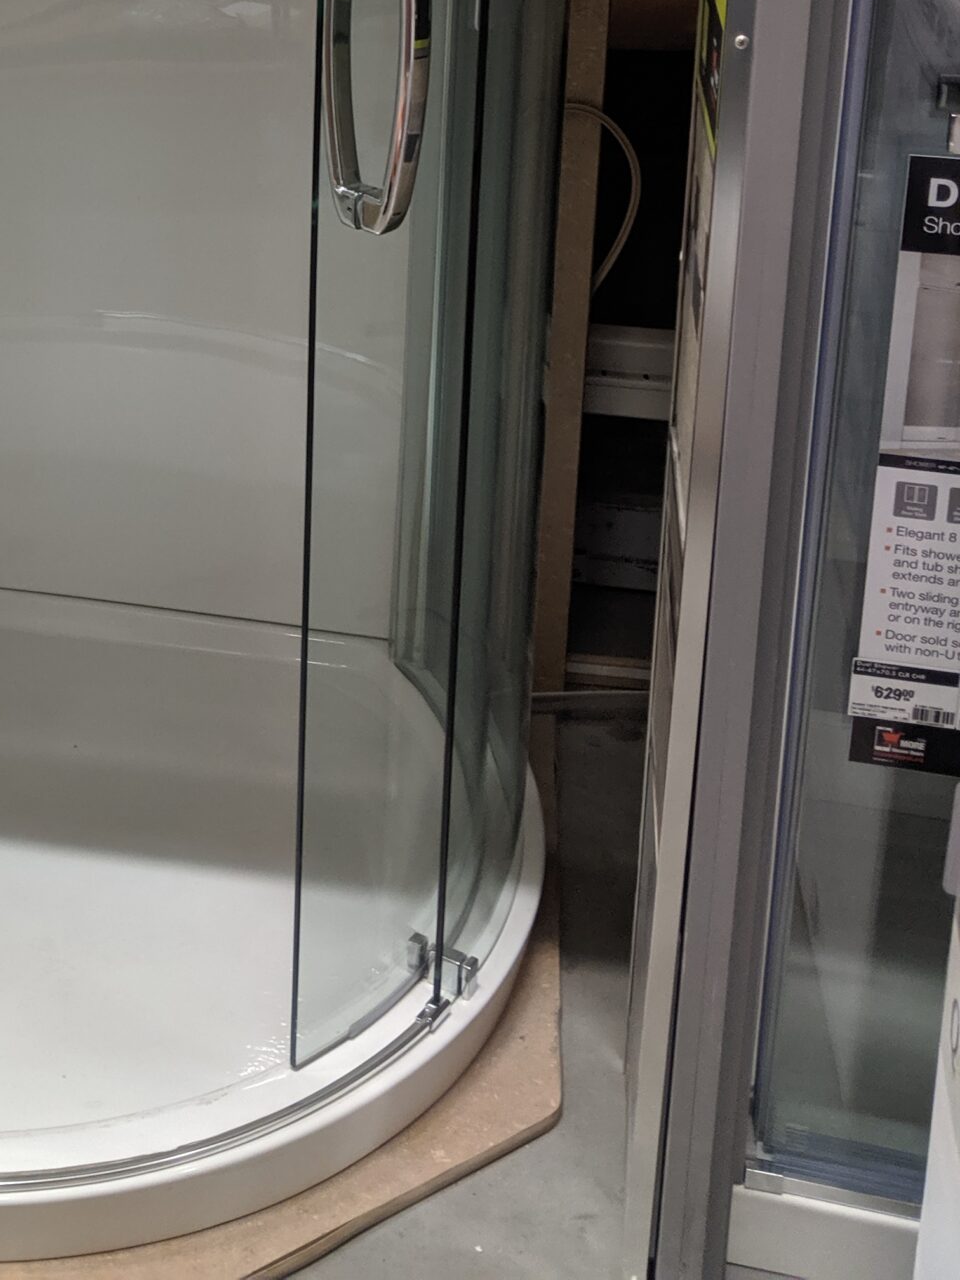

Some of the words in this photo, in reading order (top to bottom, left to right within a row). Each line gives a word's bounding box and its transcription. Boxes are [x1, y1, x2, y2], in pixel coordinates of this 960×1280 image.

[896, 525, 945, 541] Elegant
[948, 531, 958, 543] 8
[894, 543, 918, 557] Fits
[892, 559, 919, 570] and
[921, 561, 944, 573] tub
[891, 570, 944, 586] extends
[889, 586, 916, 600] Two
[918, 590, 959, 608] sliding
[888, 601, 946, 618] entryway
[887, 613, 901, 623] or
[903, 615, 921, 625] on
[923, 616, 944, 629] the
[885, 629, 918, 643] Door
[920, 634, 948, 647] sold
[884, 642, 912, 655] with
